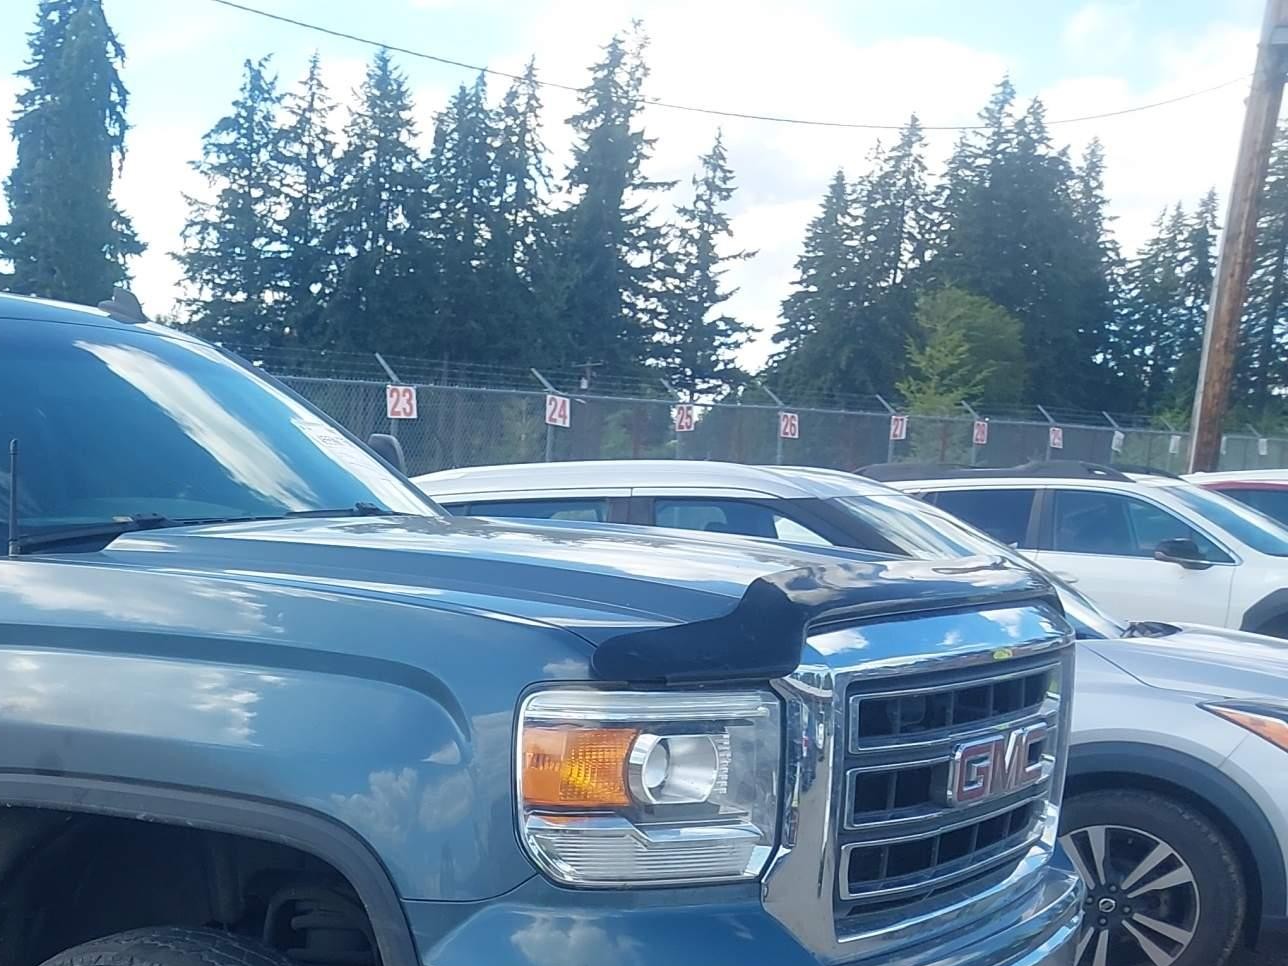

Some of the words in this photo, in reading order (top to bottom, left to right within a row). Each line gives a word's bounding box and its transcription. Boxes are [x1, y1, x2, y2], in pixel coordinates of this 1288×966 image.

[389, 387, 413, 417] 23
[548, 397, 567, 424] 24
[677, 405, 692, 430] 25
[782, 414, 797, 436] 26
[893, 417, 905, 438] 27
[950, 722, 1048, 804] GMC
